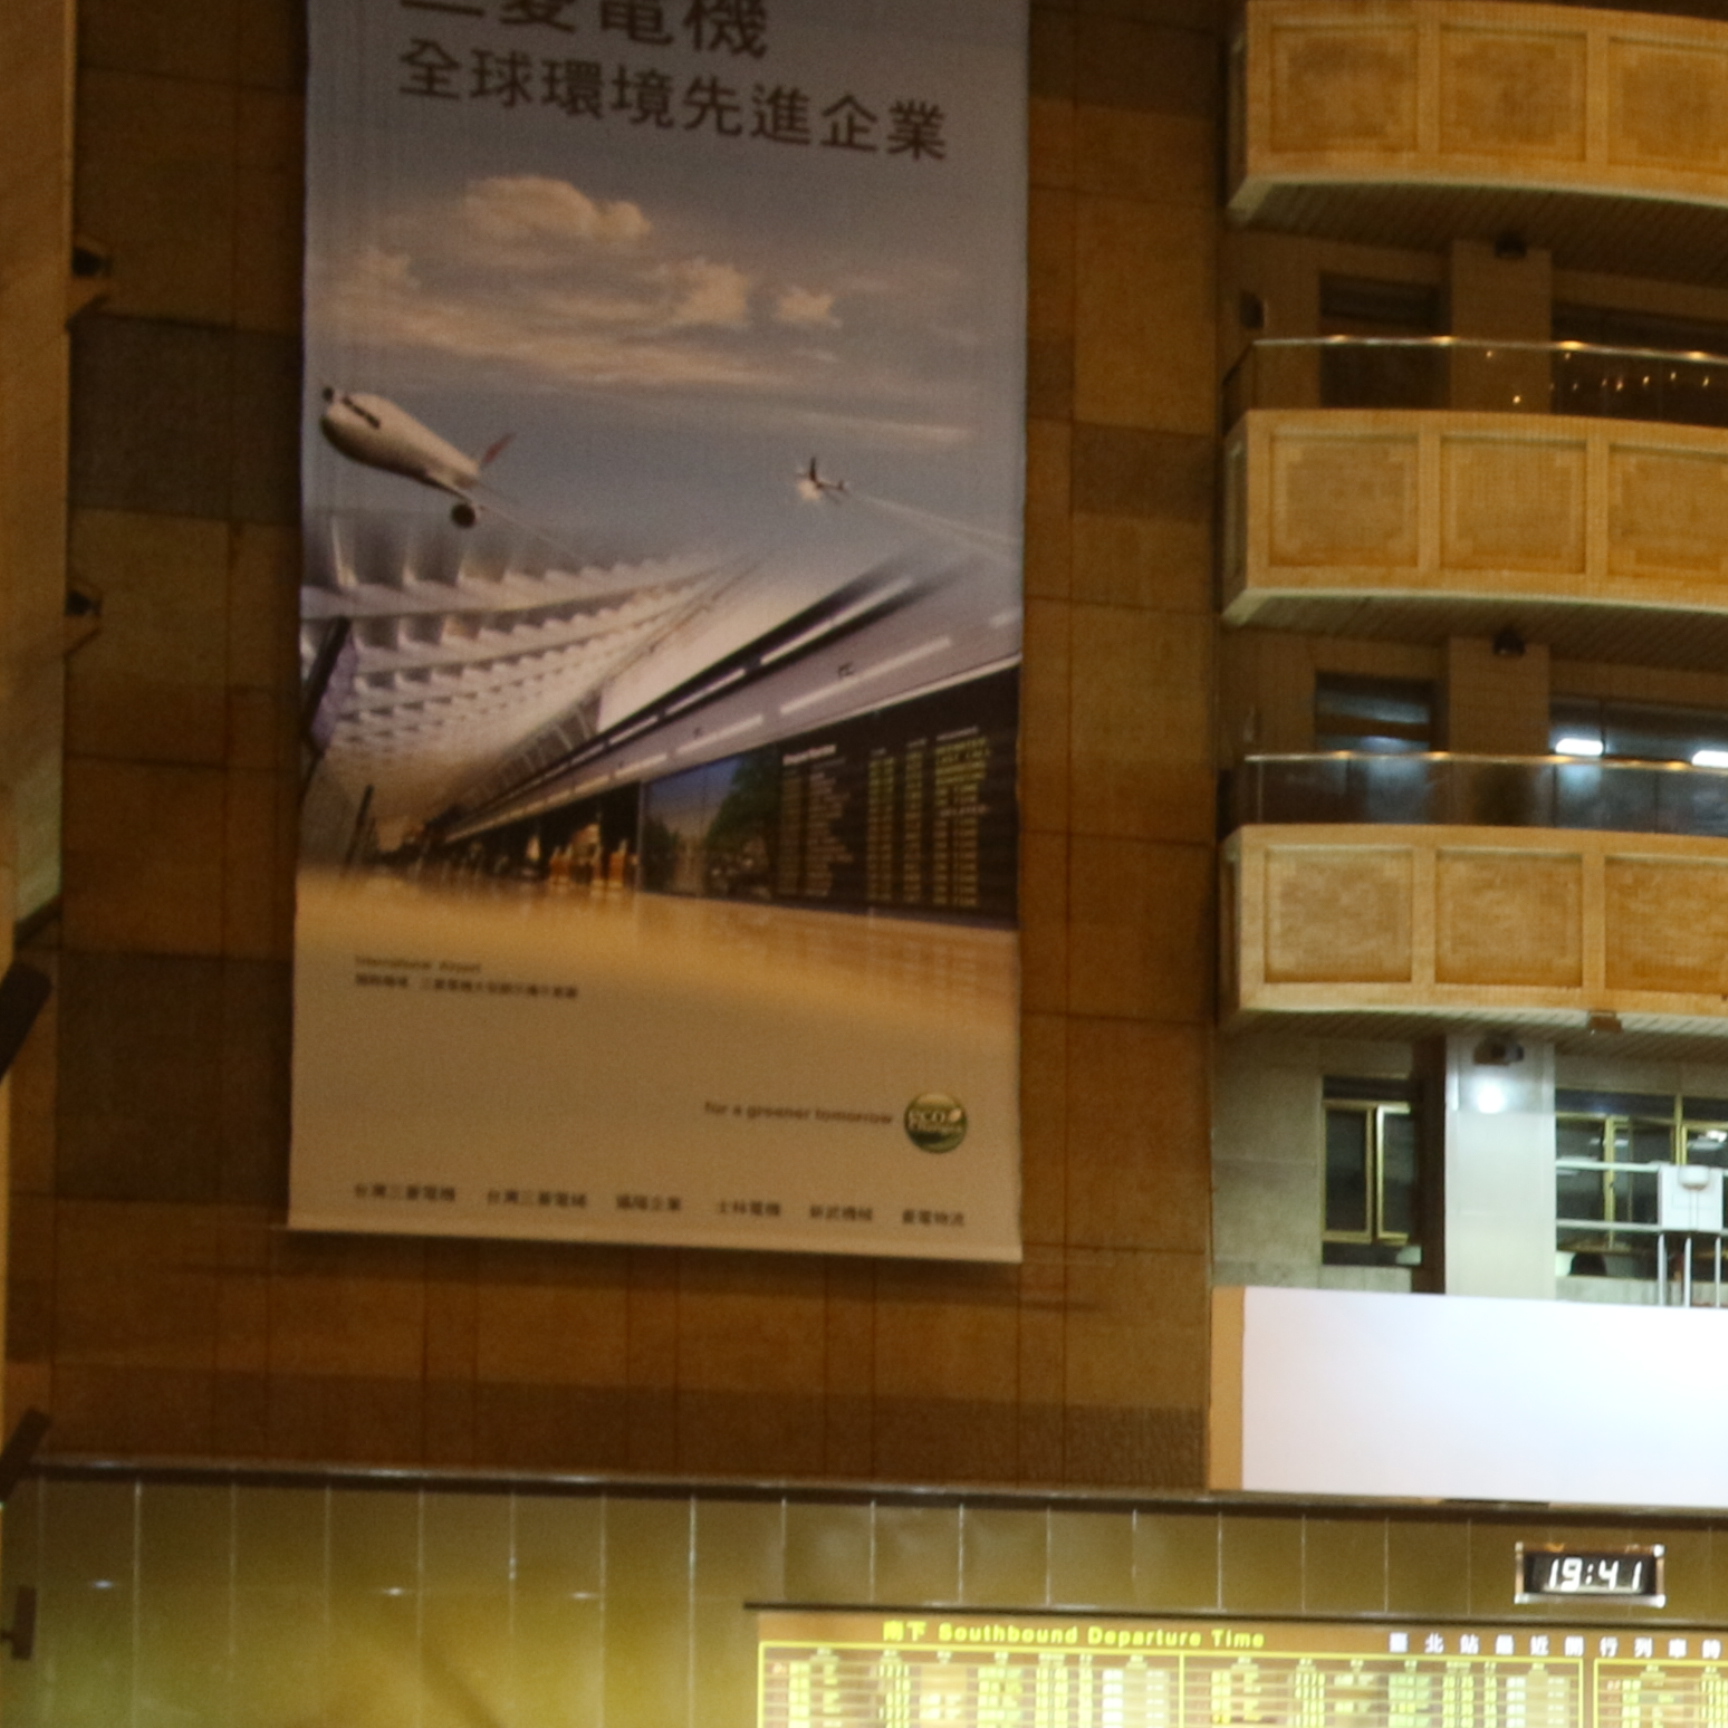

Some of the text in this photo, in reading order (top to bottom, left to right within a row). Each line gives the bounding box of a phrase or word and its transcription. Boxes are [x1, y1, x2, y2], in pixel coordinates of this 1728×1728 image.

[400, 38, 948, 161] 全球環境先進企業
[1548, 1557, 1643, 1592] 19:41
[938, 1621, 1079, 1646] Southbound
[1087, 1625, 1203, 1649] Departure
[1211, 1628, 1265, 1649] Time
